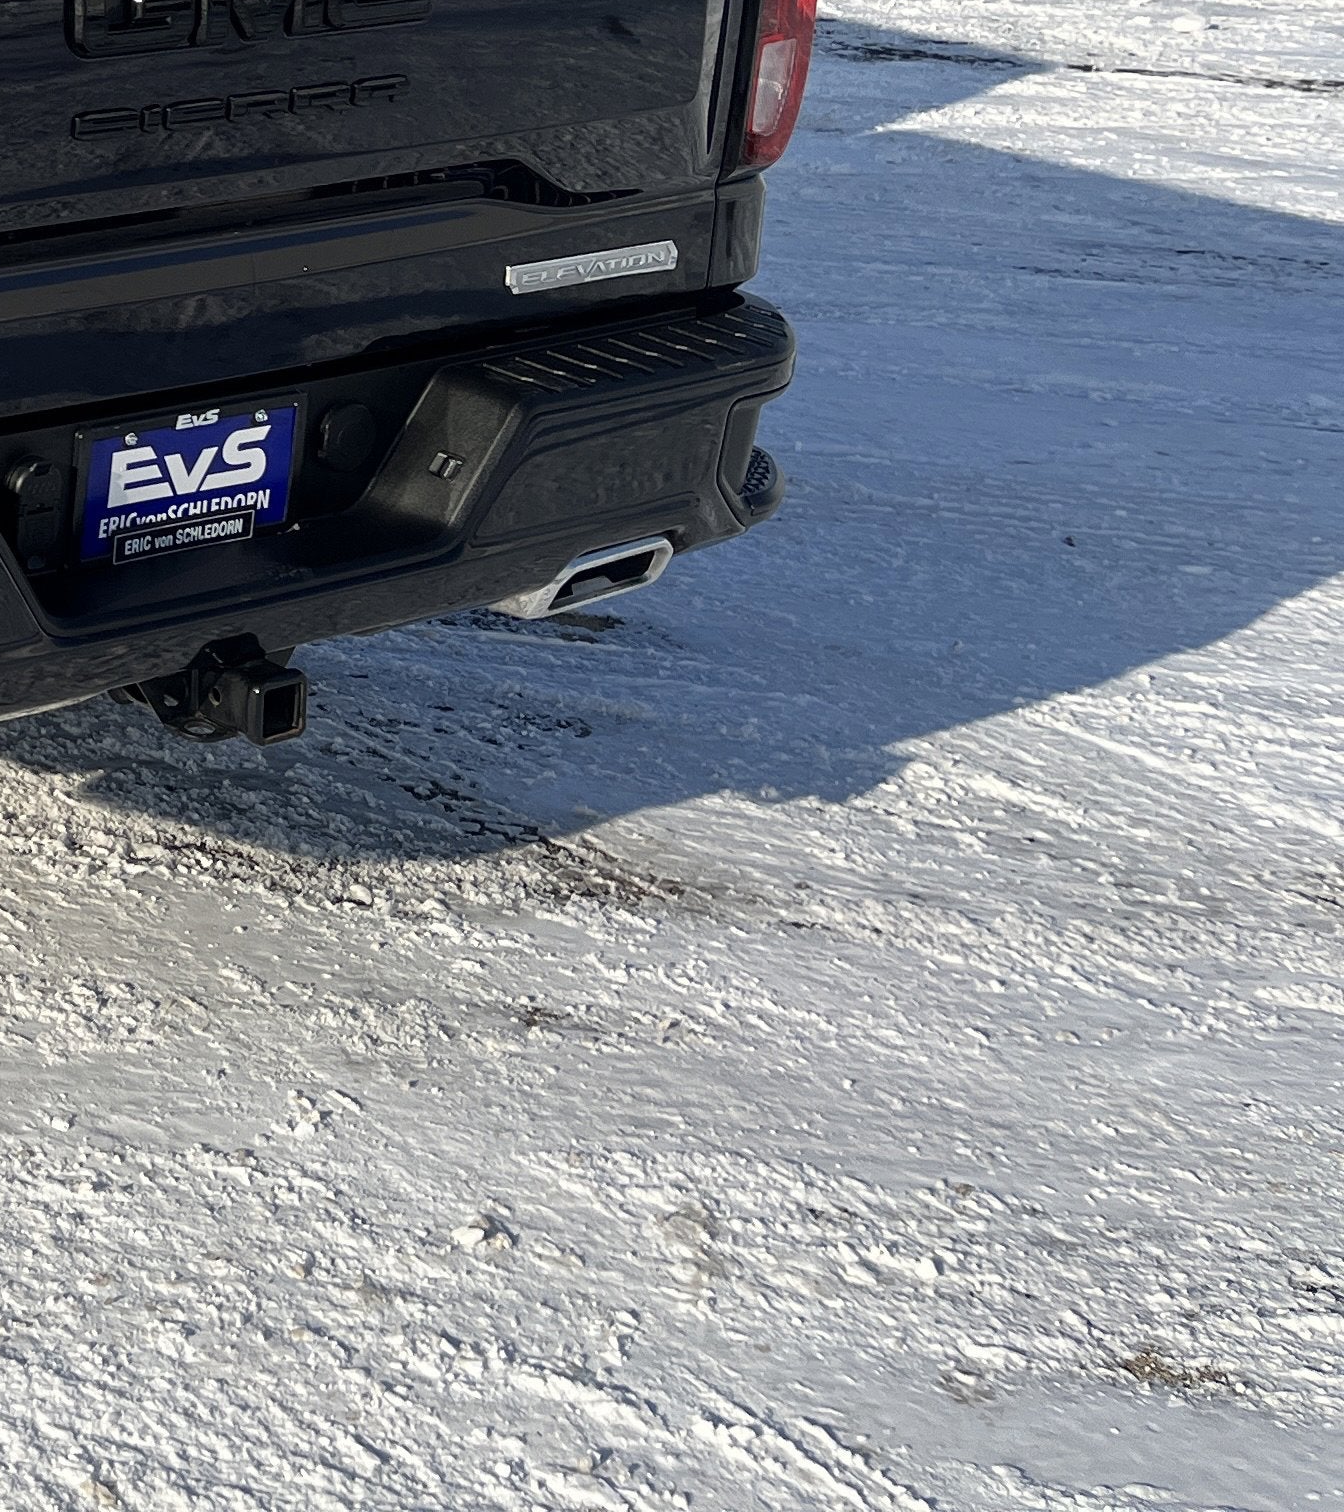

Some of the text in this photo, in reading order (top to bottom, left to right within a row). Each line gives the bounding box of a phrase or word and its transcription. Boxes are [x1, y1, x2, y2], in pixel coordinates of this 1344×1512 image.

[521, 250, 665, 286] ELEVATION
[124, 518, 244, 556] ERIC von SCHLEDORN
